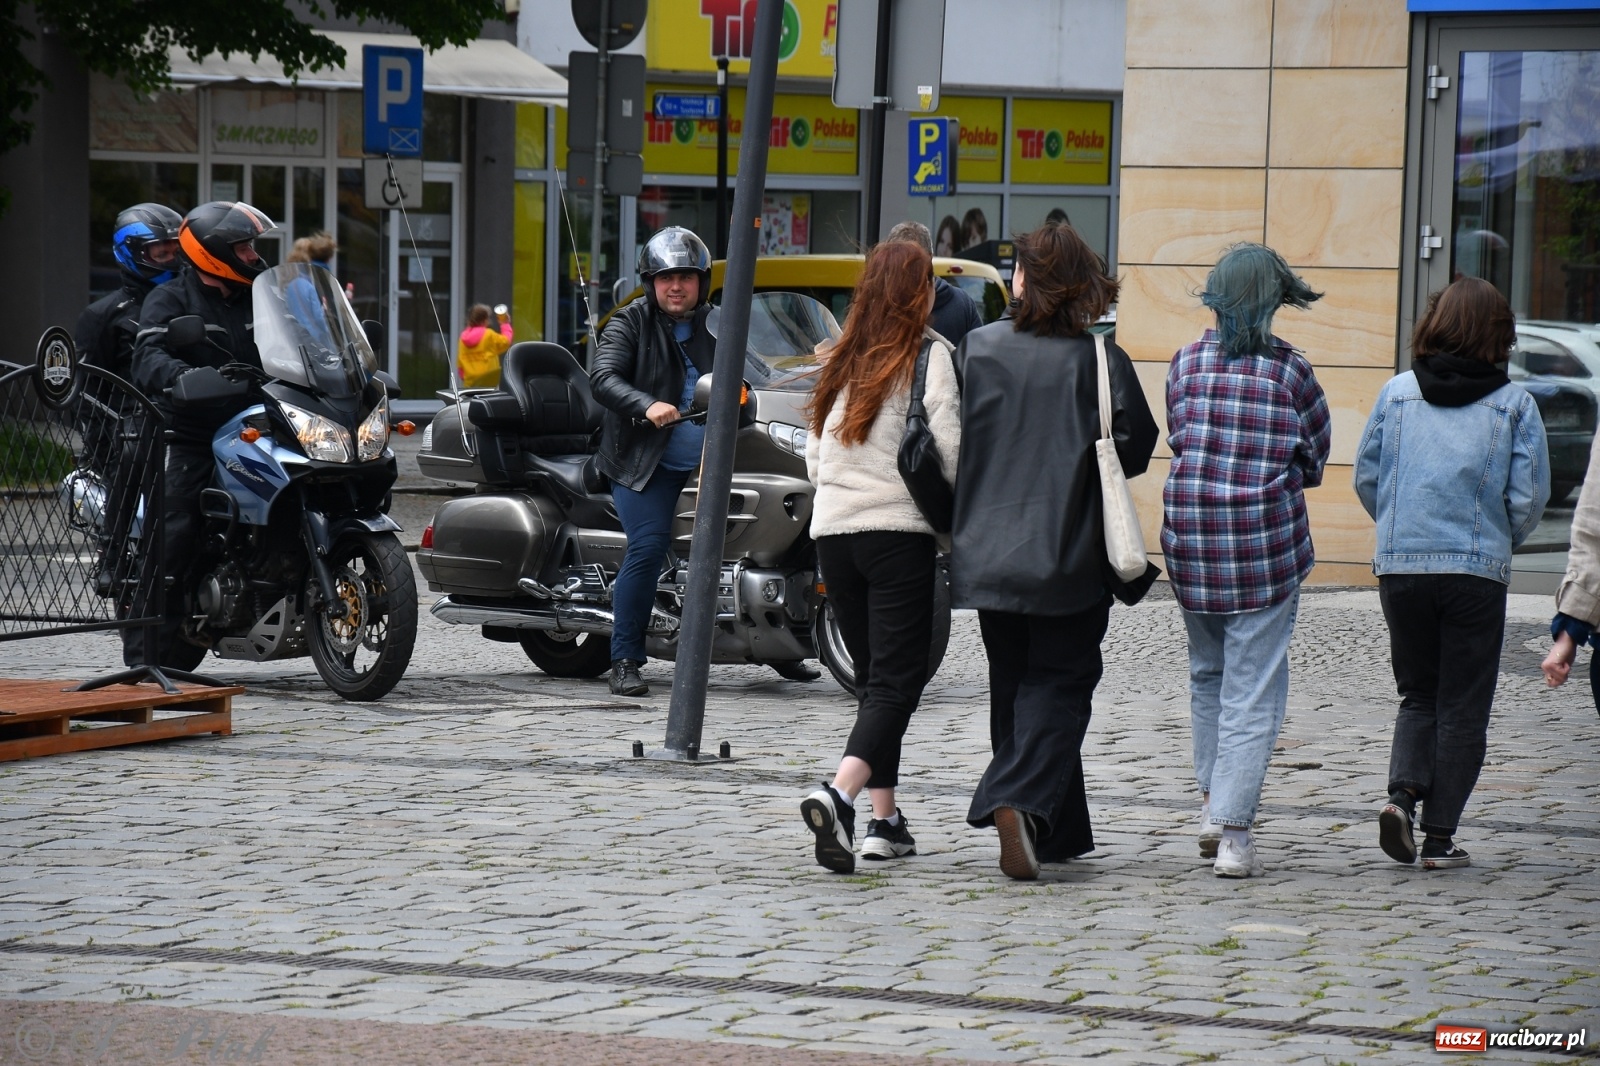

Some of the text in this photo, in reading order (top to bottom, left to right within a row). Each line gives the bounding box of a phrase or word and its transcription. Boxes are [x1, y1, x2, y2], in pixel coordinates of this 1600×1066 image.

[378, 56, 411, 122] P
[216, 124, 318, 146] SMACZNEGO
[813, 117, 856, 138] Polska
[959, 125, 998, 145] Polska
[919, 122, 940, 156] P
[1066, 130, 1105, 149] Polska
[911, 183, 944, 193] PARKOMAT
